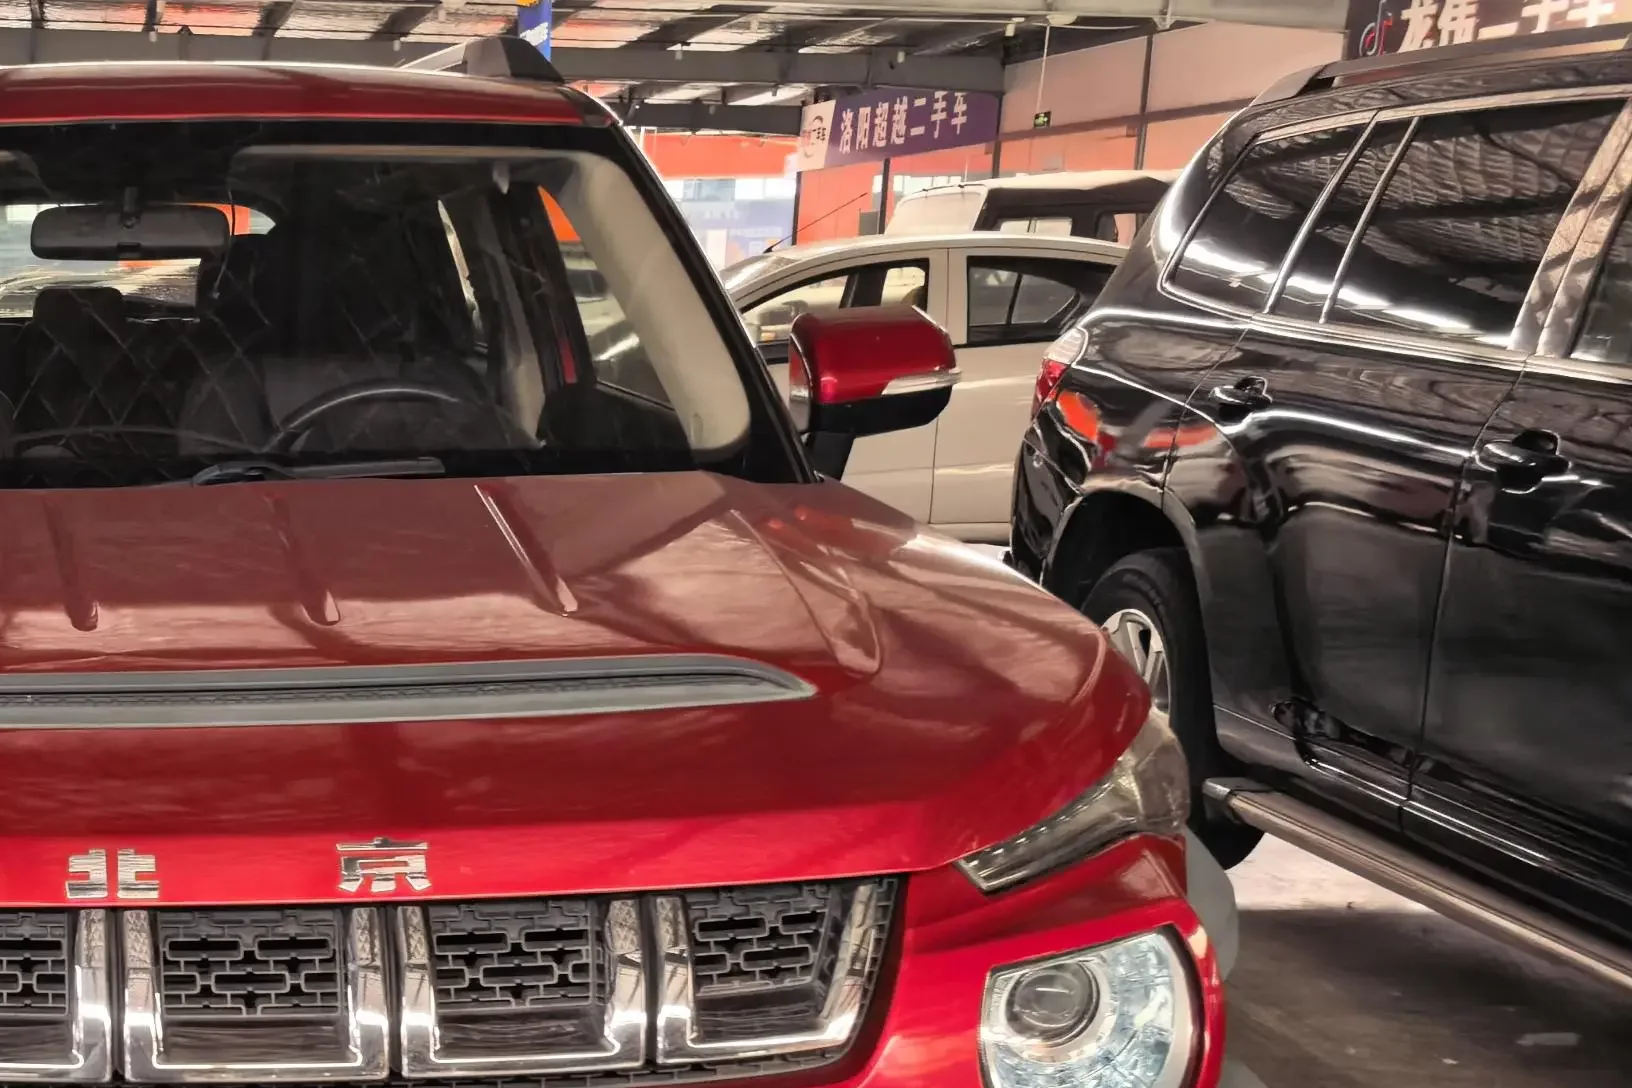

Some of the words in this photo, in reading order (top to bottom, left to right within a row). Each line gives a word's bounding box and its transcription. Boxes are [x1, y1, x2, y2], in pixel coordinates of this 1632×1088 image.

[839, 91, 968, 154] 洛阳超越二手车
